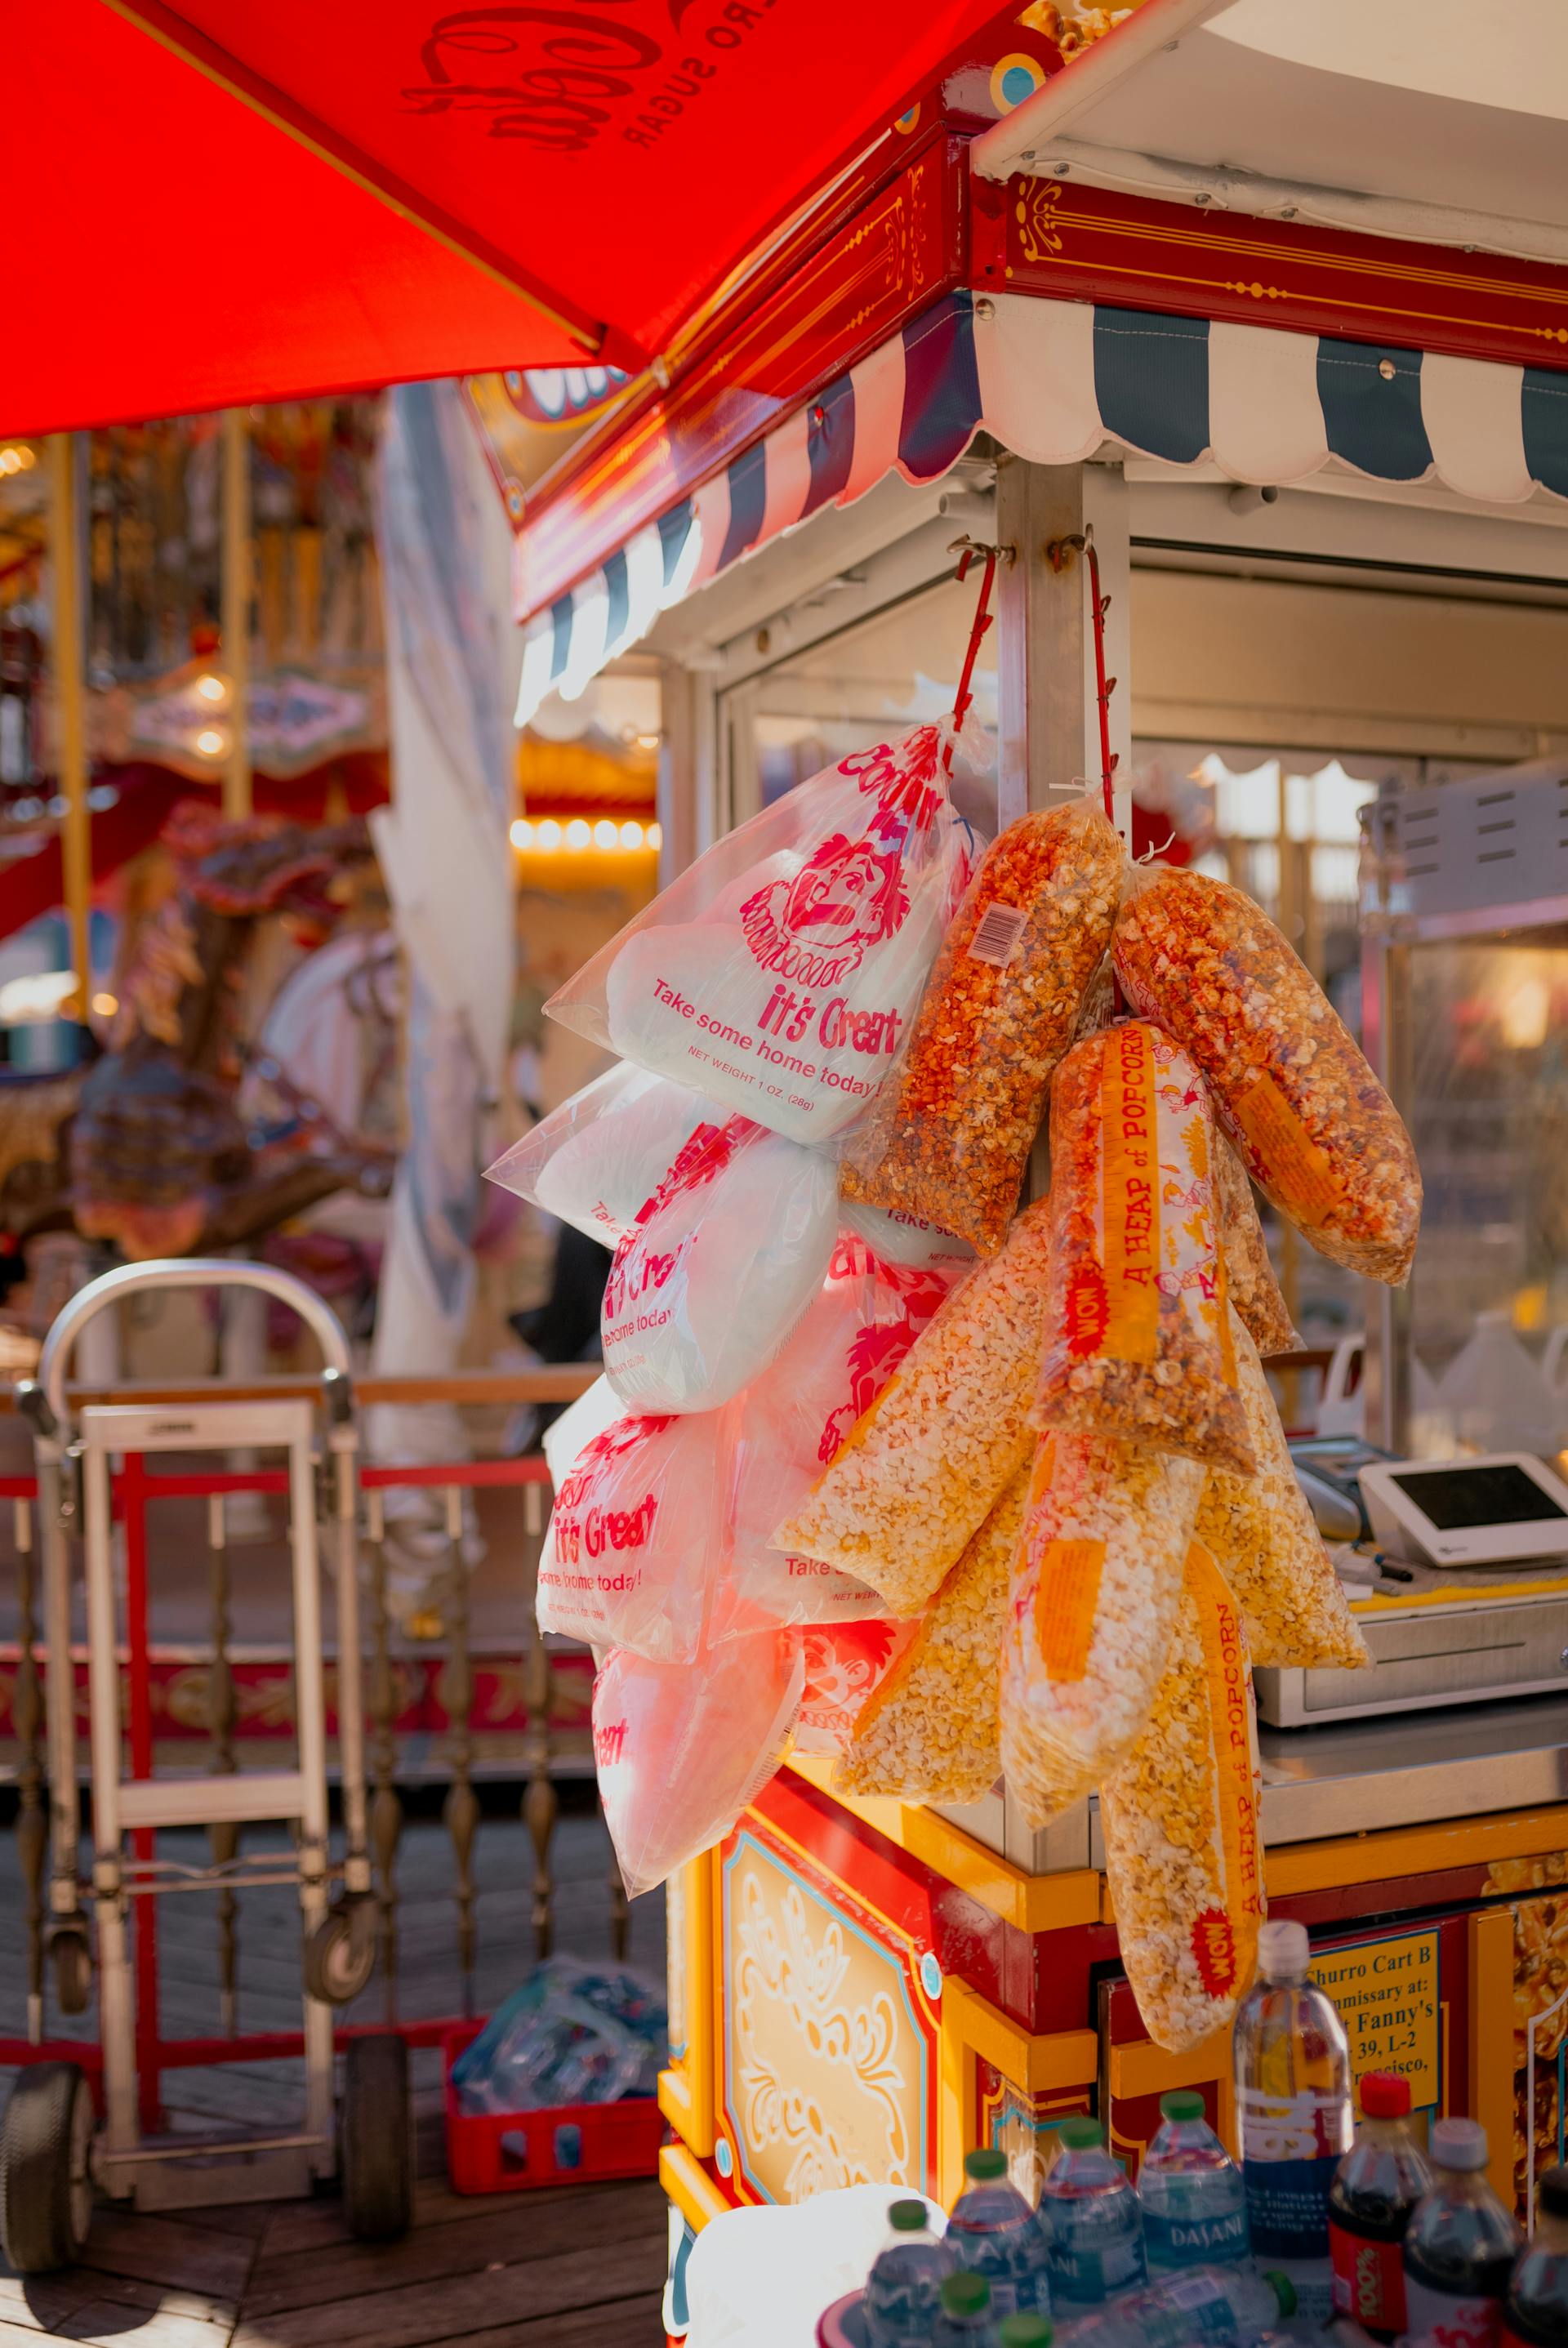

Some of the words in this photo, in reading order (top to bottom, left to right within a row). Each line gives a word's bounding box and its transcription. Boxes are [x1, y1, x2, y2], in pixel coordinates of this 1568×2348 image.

[653, 978, 695, 1018] Take
[697, 1014, 753, 1050] some
[756, 1040, 816, 1079] home
[819, 1067, 883, 1098] today!
[688, 1045, 710, 1063] NET
[711, 1057, 756, 1085] WEIGHT
[758, 1080, 764, 1089] 1
[788, 1094, 815, 1112] (28g)
[1120, 1029, 1147, 1139] POPCORN
[1124, 1147, 1148, 1167] of
[1124, 1178, 1152, 1257] HEAP
[1075, 1287, 1099, 1340] WOW
[585, 1493, 658, 1558] Great
[785, 1557, 831, 1576] Take
[833, 1593, 851, 1602] NET
[1216, 1603, 1247, 1753] POPCORN
[1233, 1762, 1247, 1782] of
[1238, 1796, 1256, 1887] HEAP
[1202, 1923, 1232, 1981] WOW
[1373, 1951, 1412, 1974] Cart
[1419, 1946, 1431, 1964] B
[1408, 1978, 1428, 1994] at:
[1357, 2000, 1433, 2034] Fanny's
[1358, 2041, 1383, 2061] 39,
[1388, 2030, 1416, 2052] L-2
[1171, 2215, 1244, 2248] DASANI
[1356, 2248, 1380, 2317] 100%
